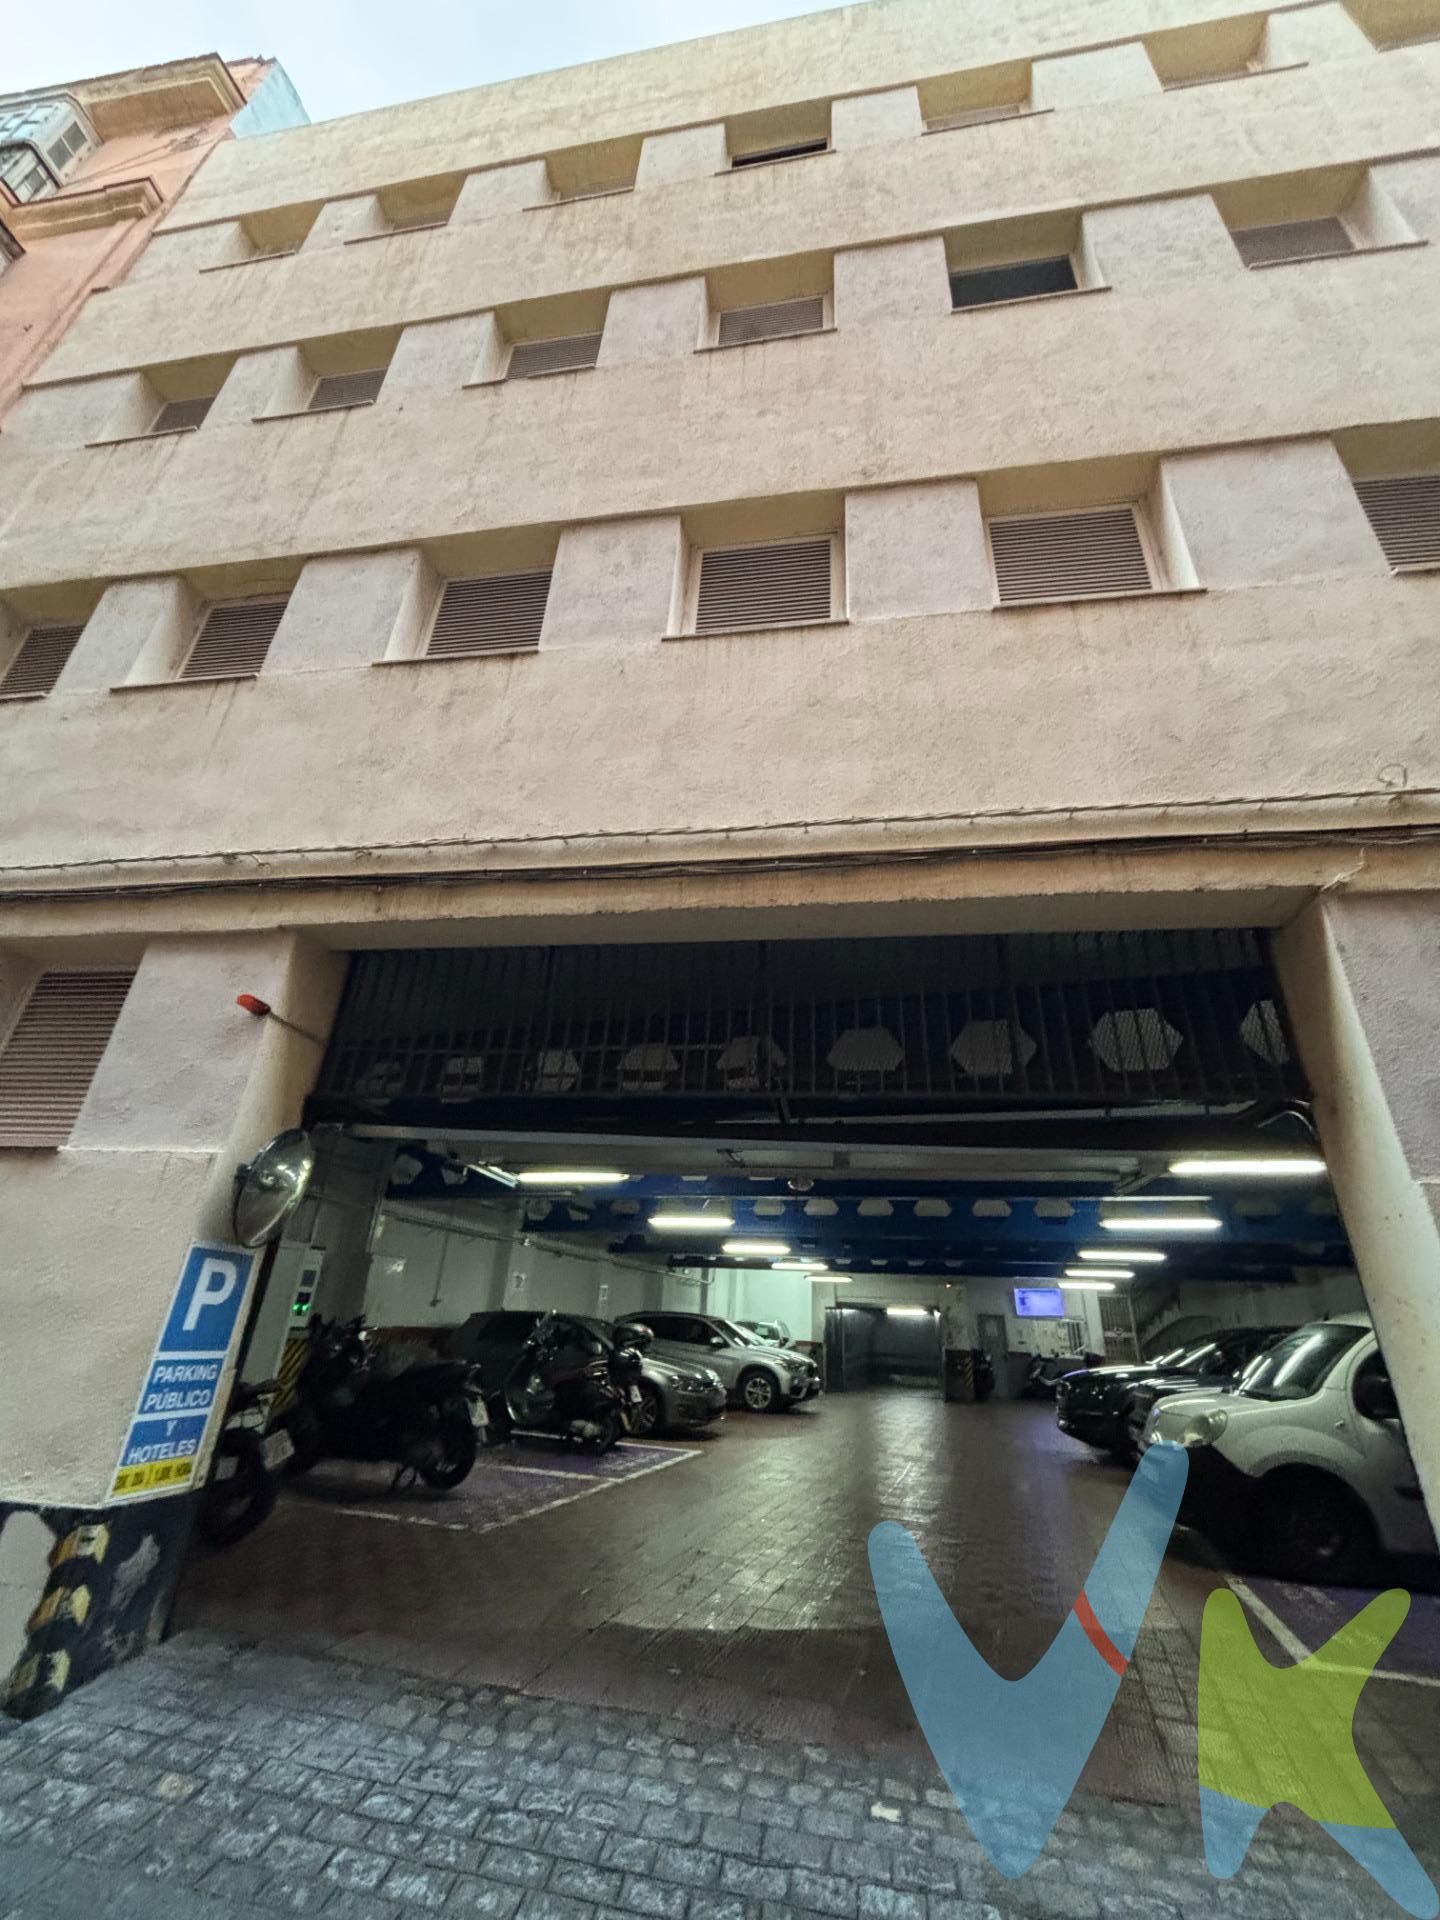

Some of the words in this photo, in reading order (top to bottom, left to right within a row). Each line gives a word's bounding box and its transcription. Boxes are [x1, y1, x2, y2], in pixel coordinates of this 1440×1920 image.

[182, 1258, 237, 1331] P
[155, 1364, 217, 1382] PARKING
[147, 1384, 210, 1410] PÚBLICO
[166, 1420, 177, 1435] Y
[129, 1440, 196, 1463] HOTELES
